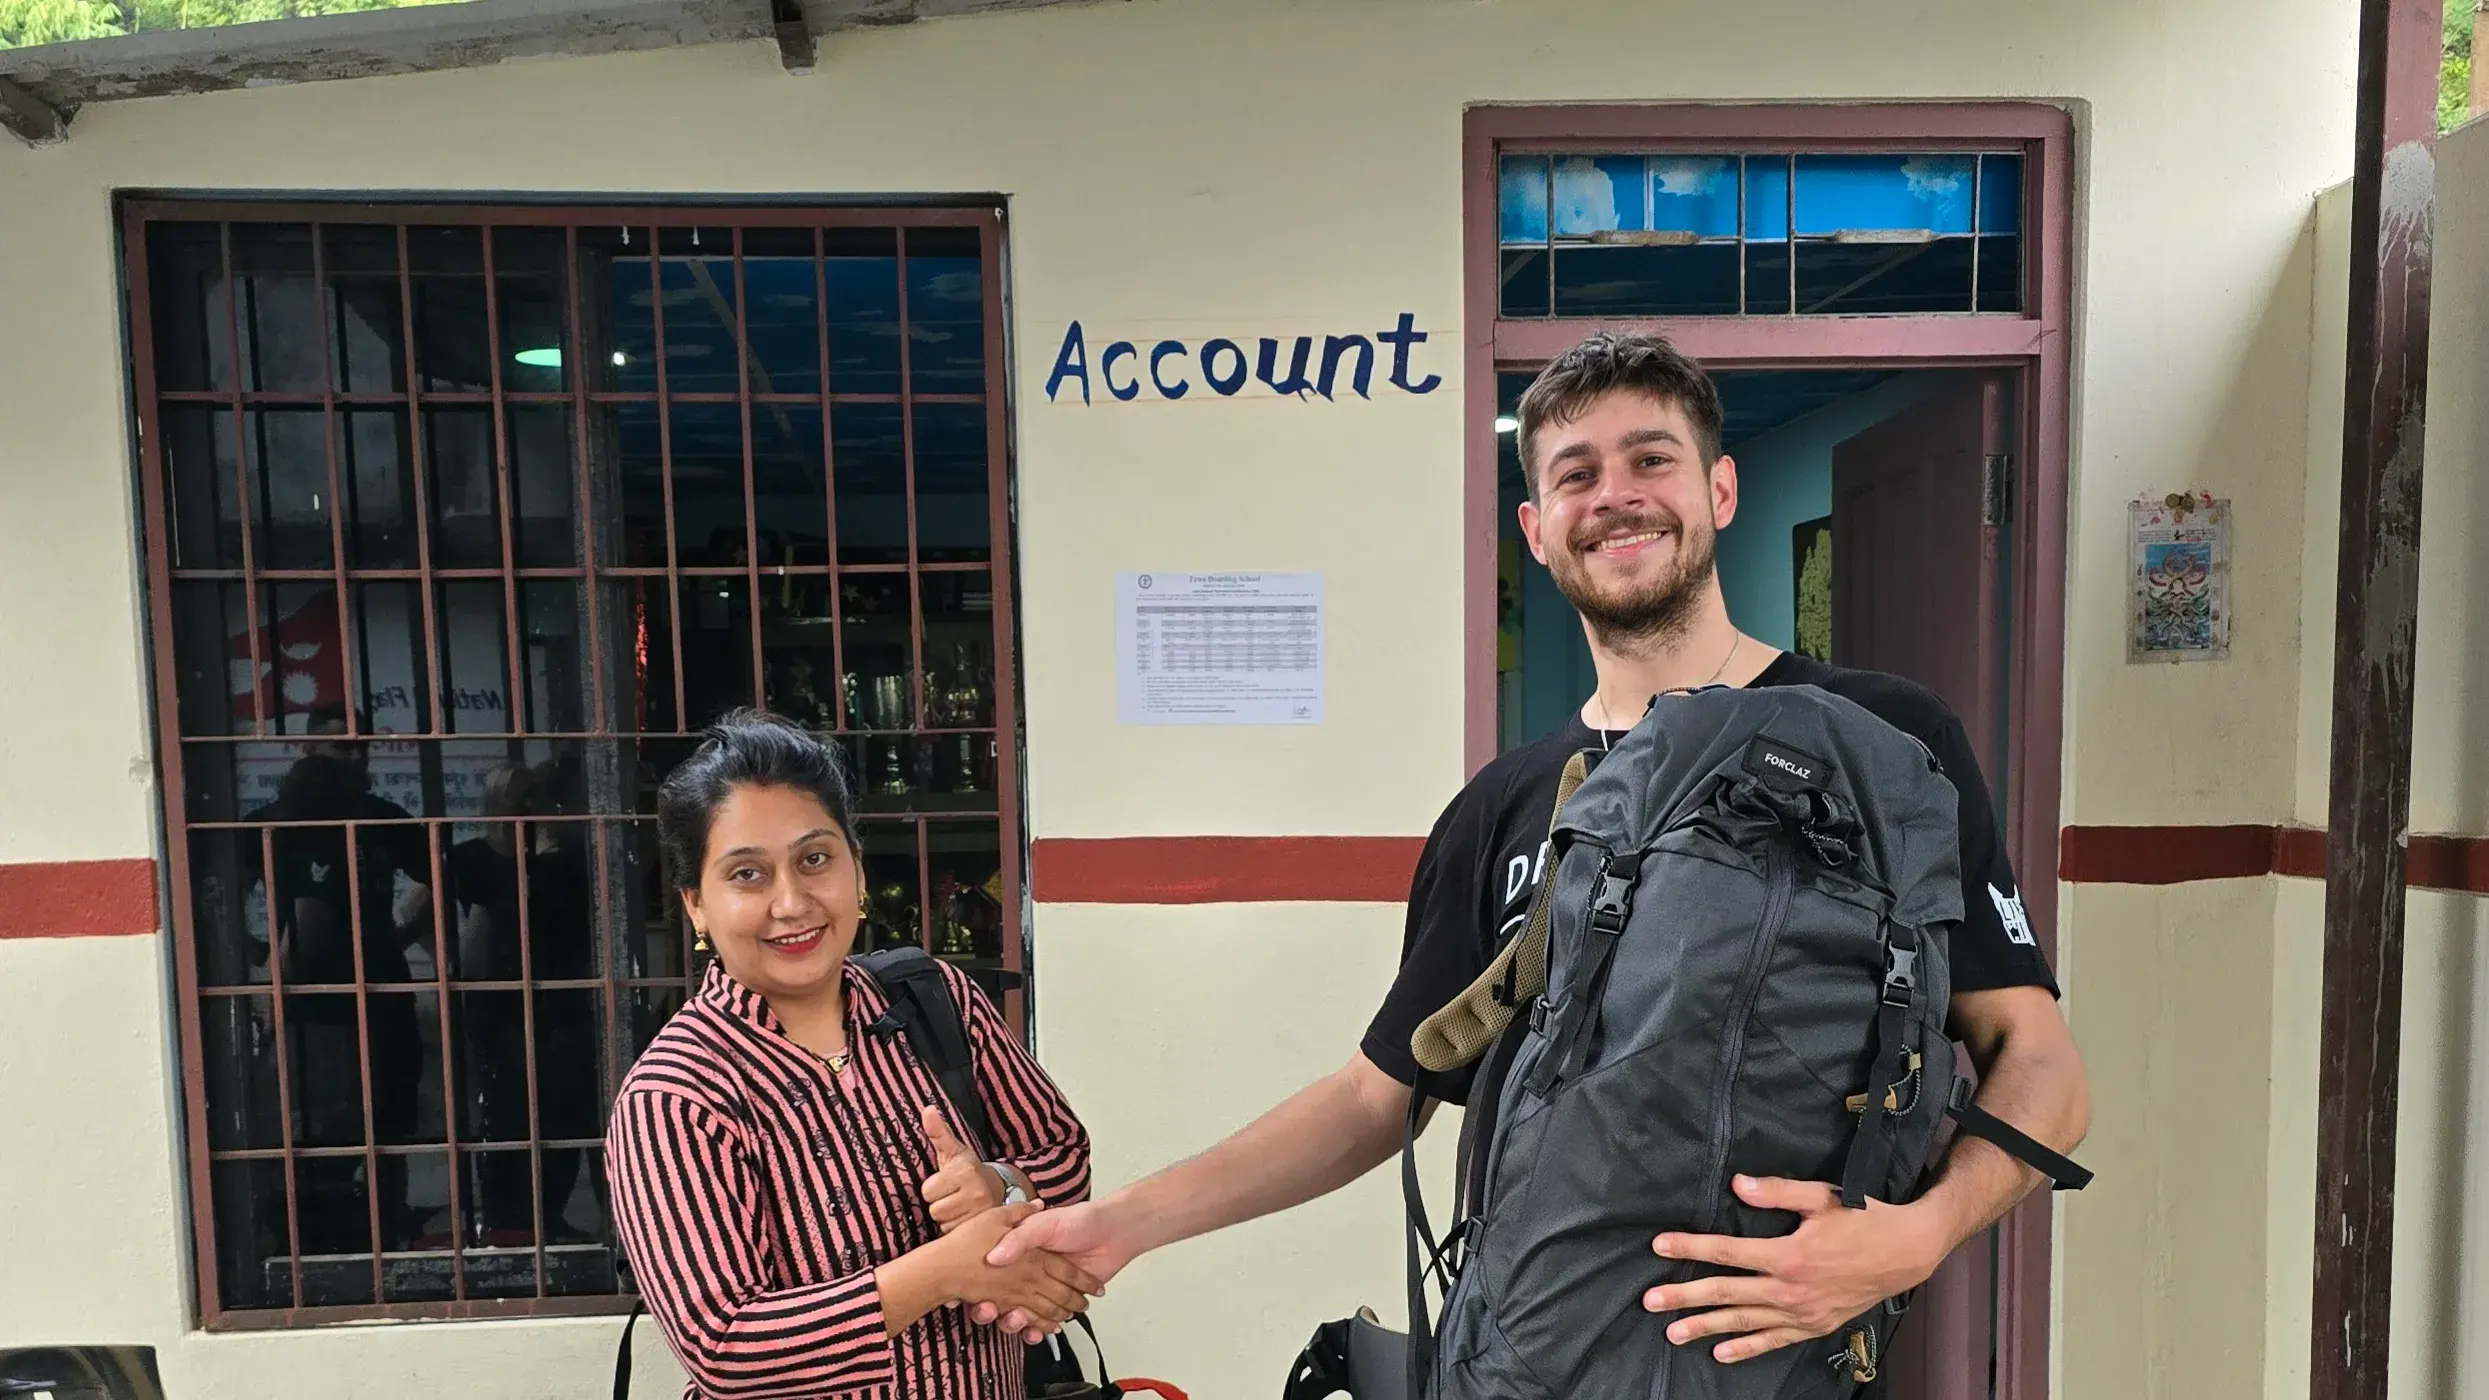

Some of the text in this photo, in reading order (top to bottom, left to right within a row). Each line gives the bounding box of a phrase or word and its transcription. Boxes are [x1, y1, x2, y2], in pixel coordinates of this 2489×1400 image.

[1045, 313, 1442, 407] Account
[1239, 575, 1260, 583] School
[1764, 752, 1811, 779] FORCLAZ
